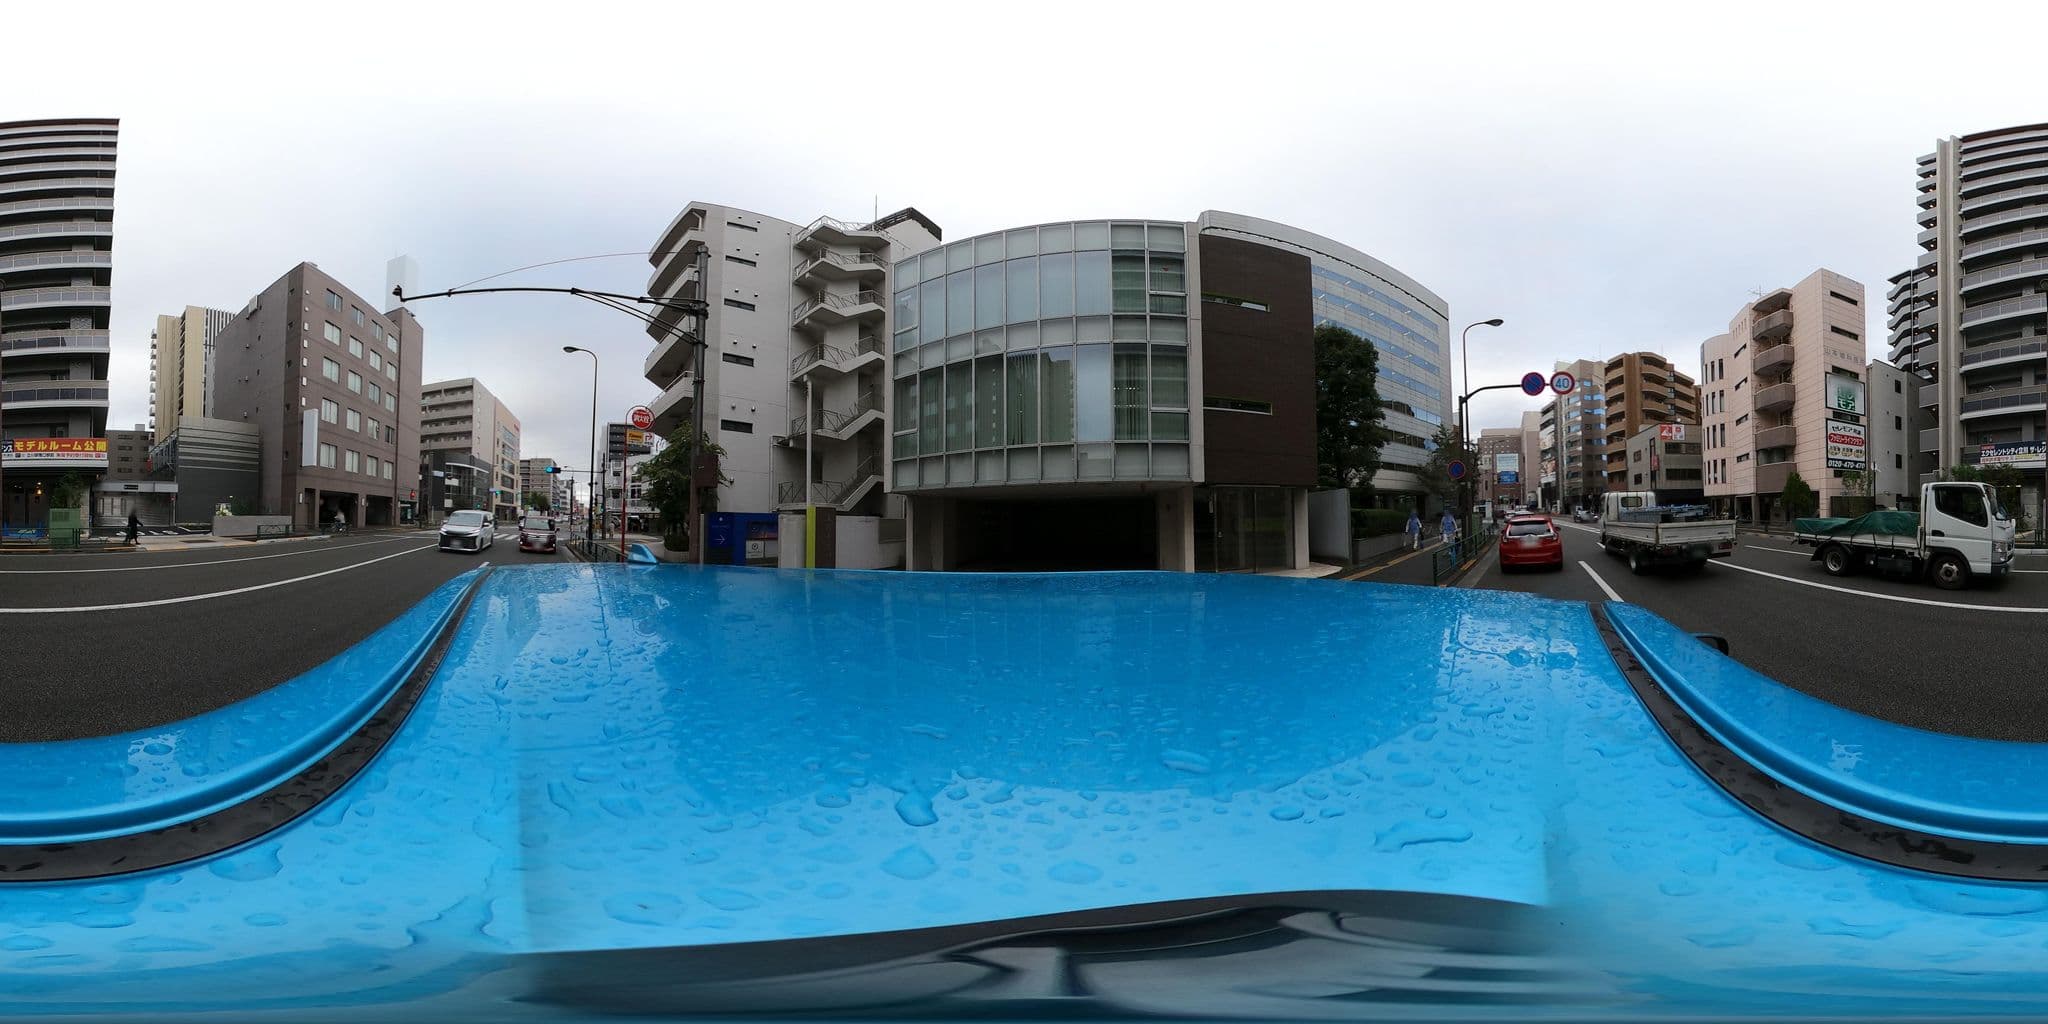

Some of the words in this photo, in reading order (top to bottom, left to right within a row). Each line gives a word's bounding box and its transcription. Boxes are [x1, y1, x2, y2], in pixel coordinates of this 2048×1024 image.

[1556, 378, 1570, 389] 40
[15, 441, 106, 451] モデルルーム公開
